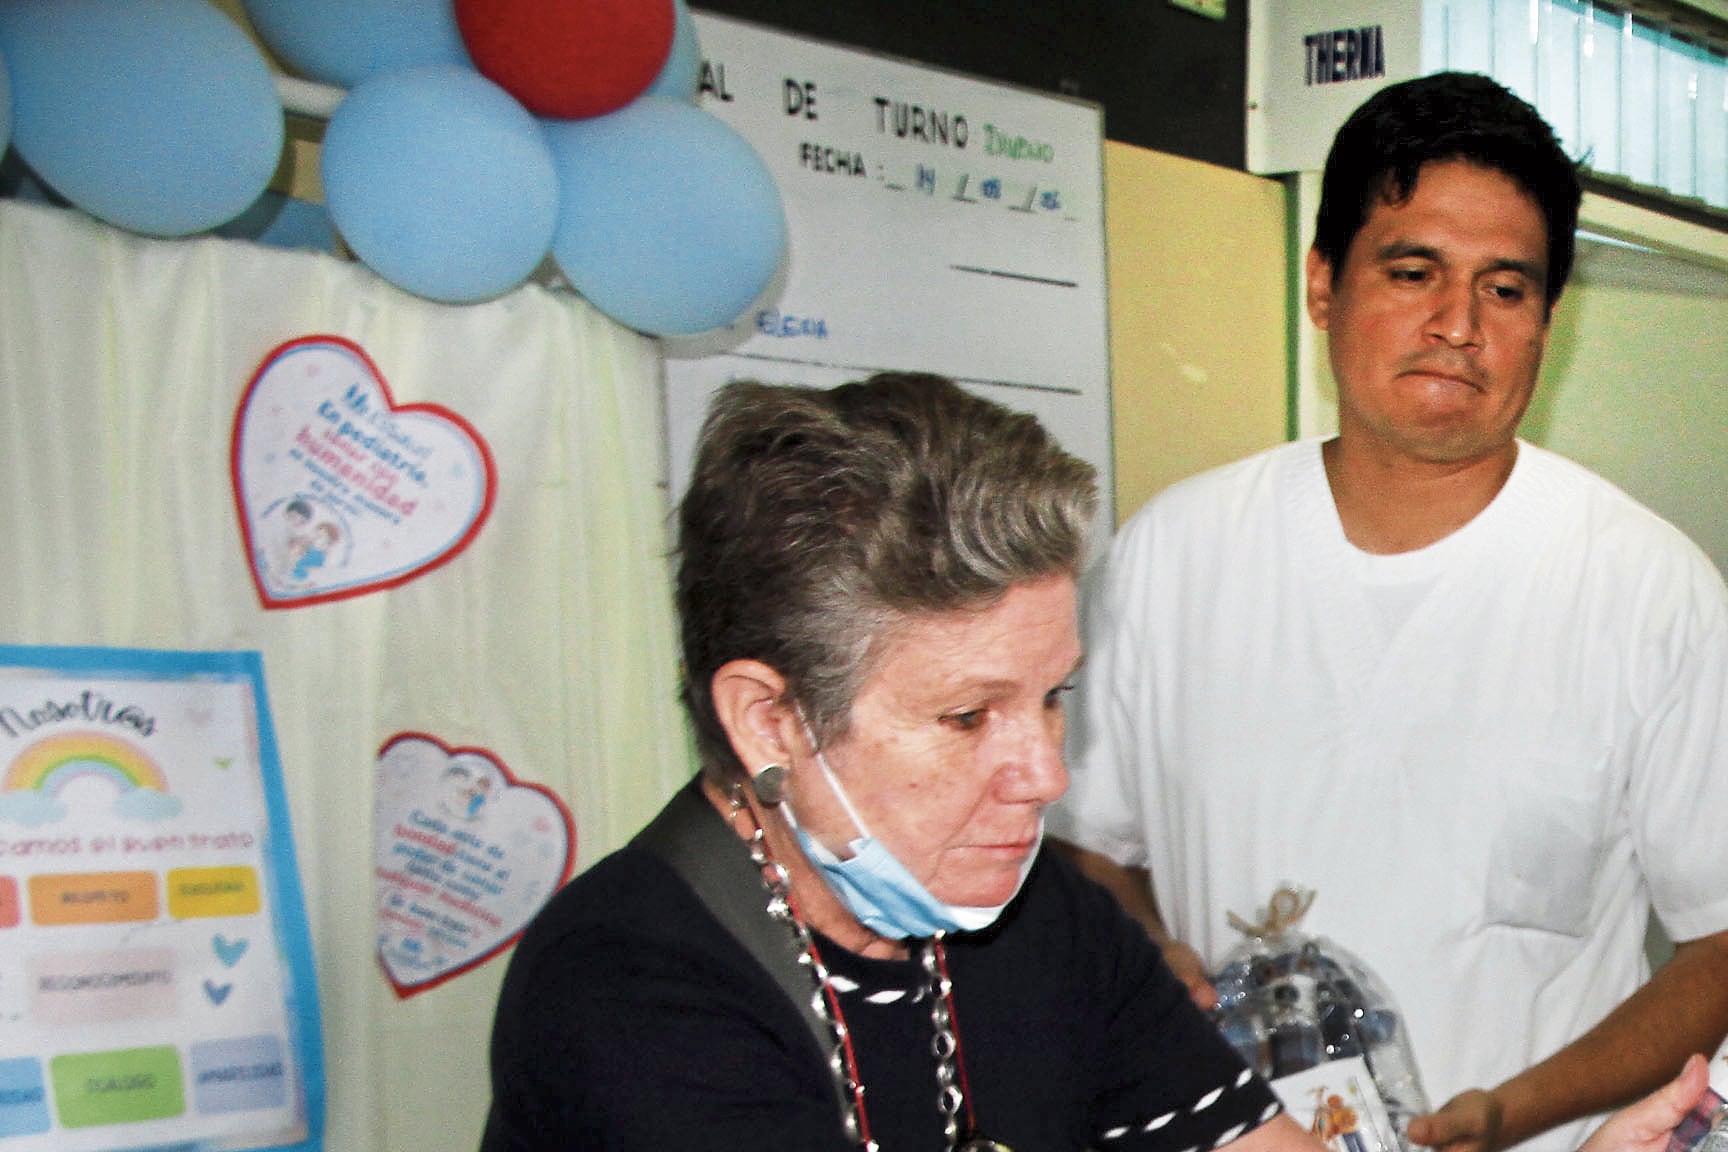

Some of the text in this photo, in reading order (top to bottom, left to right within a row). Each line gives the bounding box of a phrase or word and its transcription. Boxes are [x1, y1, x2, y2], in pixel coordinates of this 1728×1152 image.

[783, 77, 818, 120] DE
[873, 97, 969, 148] TURNO
[296, 426, 419, 516] humanidad
